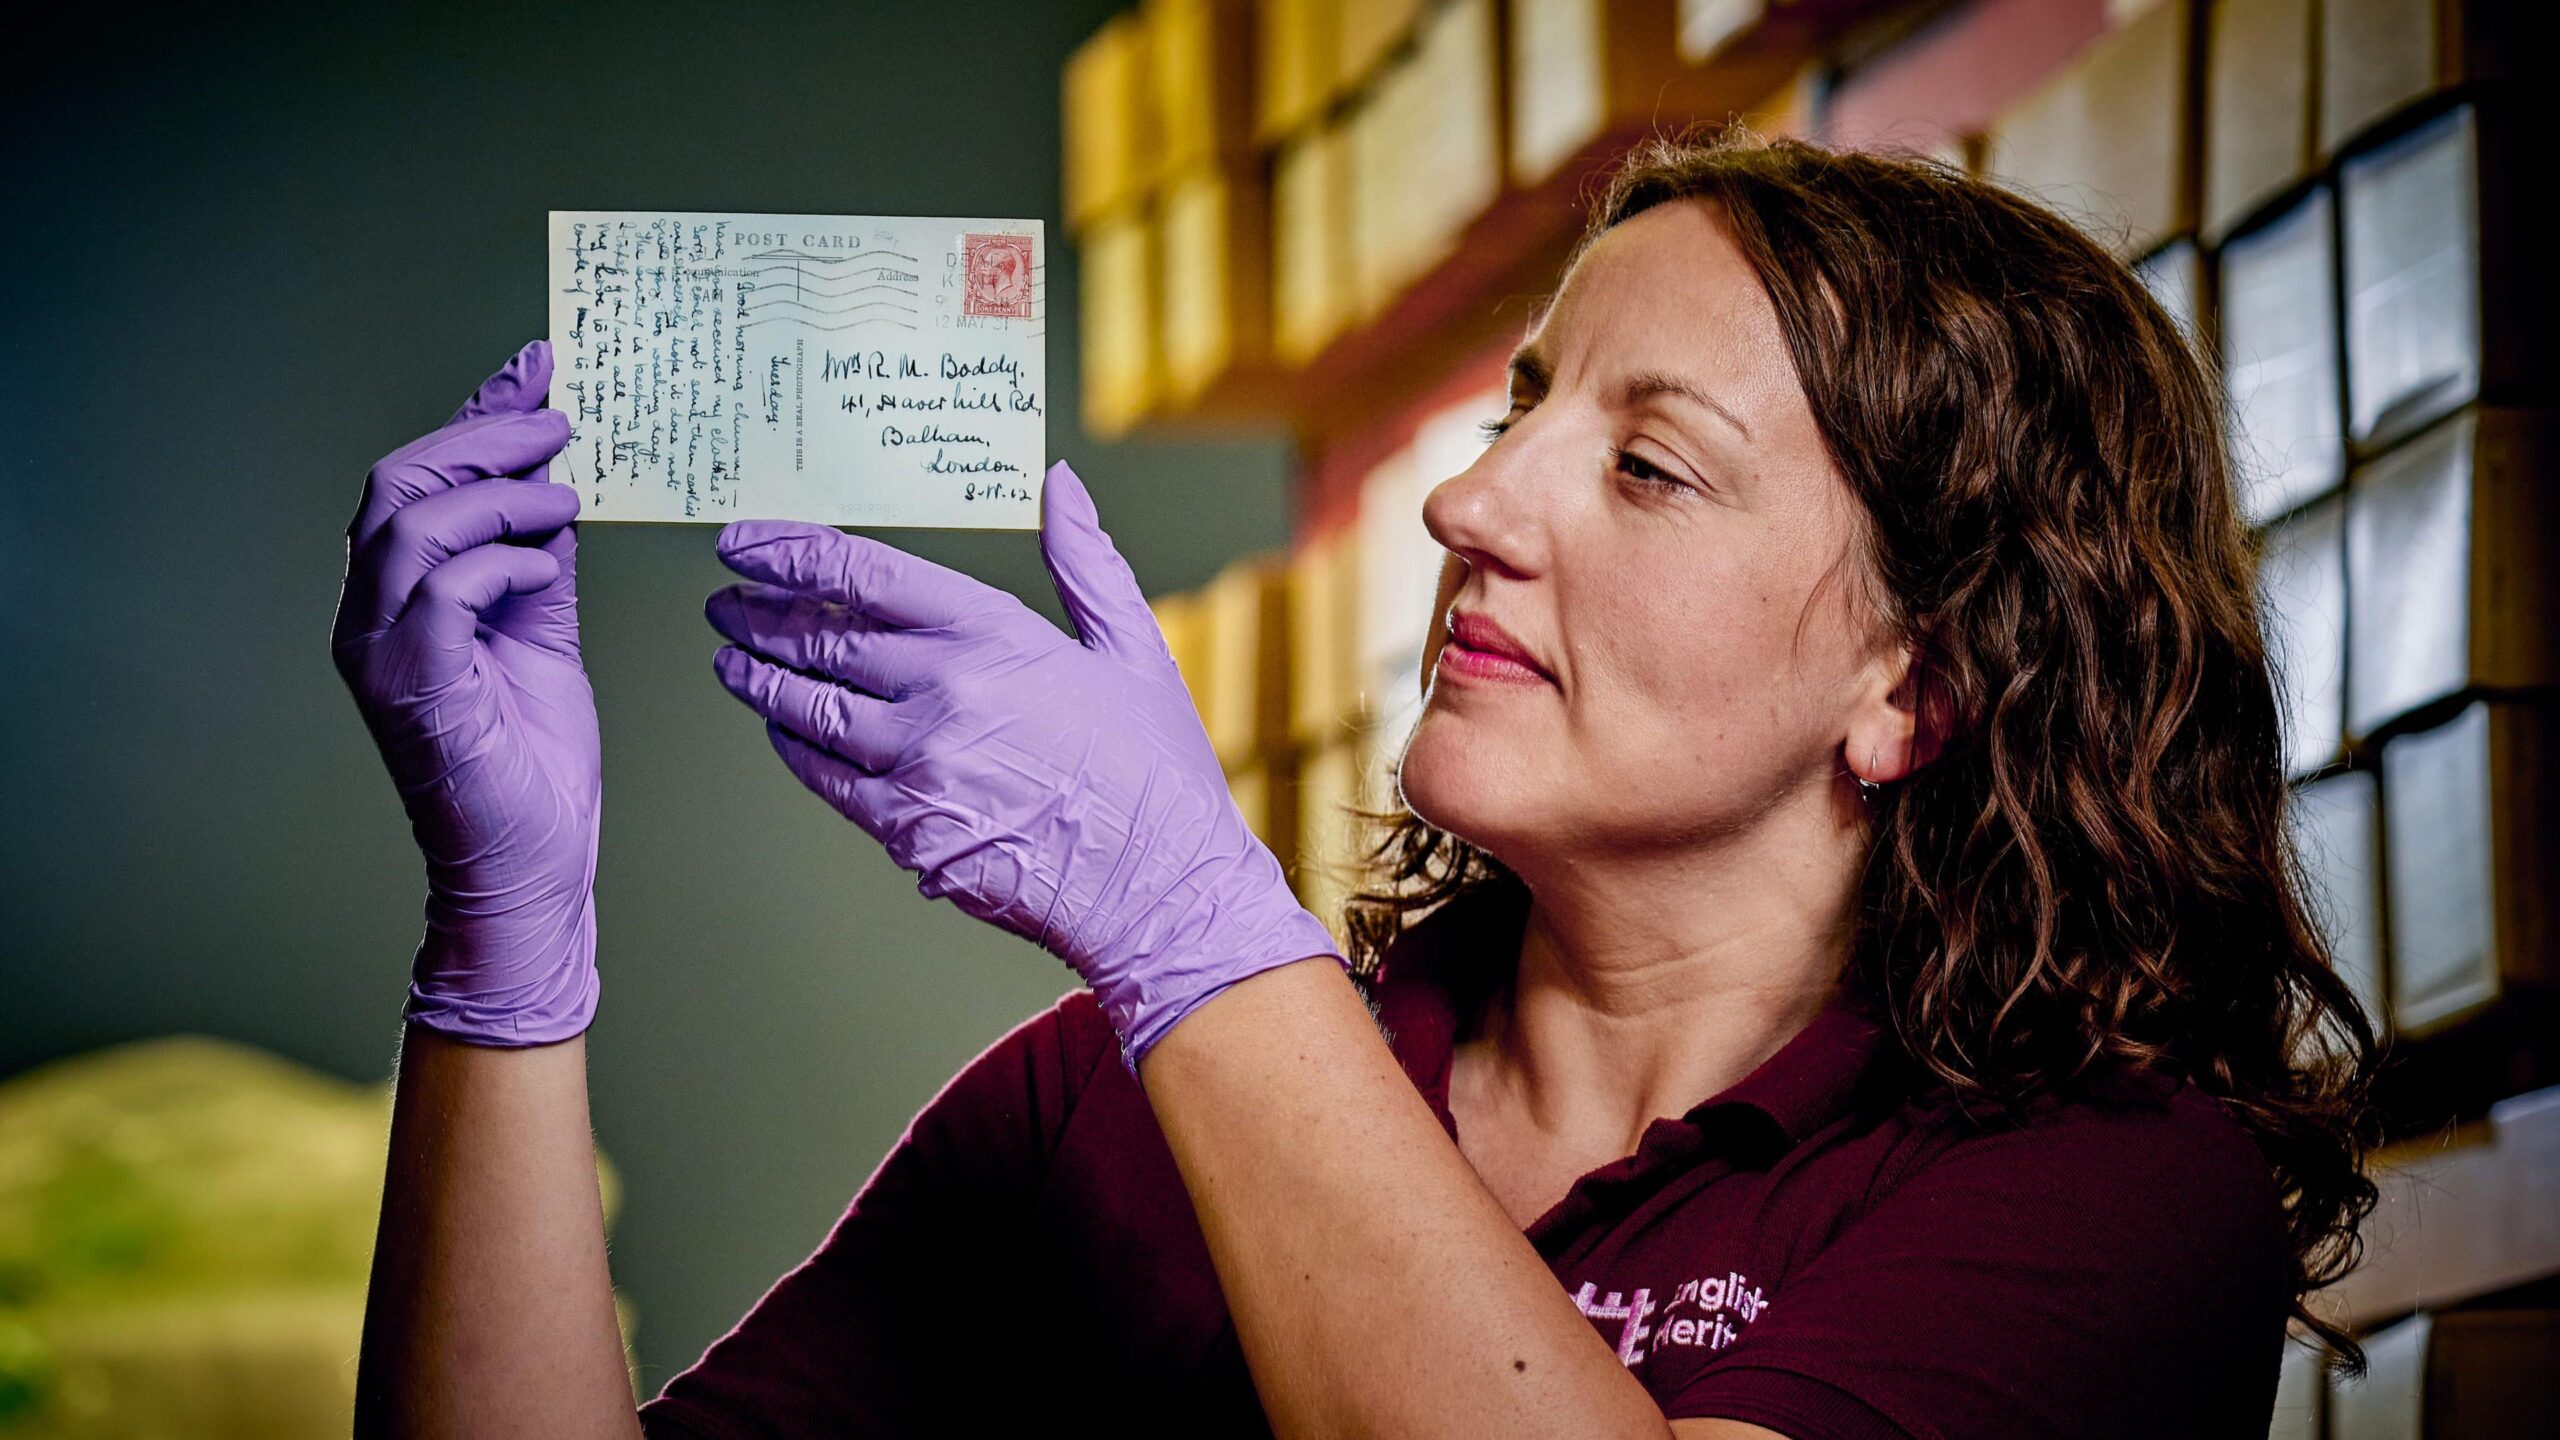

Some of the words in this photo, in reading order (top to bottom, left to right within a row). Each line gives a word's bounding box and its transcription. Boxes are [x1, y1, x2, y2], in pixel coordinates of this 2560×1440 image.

[566, 224, 590, 274] couple
[635, 231, 653, 260] The
[652, 219, 672, 260] give
[673, 221, 689, 254] and
[689, 225, 707, 262] Sorry
[716, 221, 732, 259] have
[734, 232, 788, 246] POST
[802, 233, 861, 248] CARD
[563, 279, 591, 295] of
[666, 258, 688, 328] sincerely
[877, 270, 919, 282] Address
[634, 266, 648, 328] weather
[691, 286, 703, 330] could
[737, 282, 756, 319] Good
[593, 319, 610, 332] to
[956, 315, 985, 328] MAY
[596, 342, 609, 369] the
[614, 327, 622, 357] are
[633, 337, 648, 353] is
[664, 337, 684, 376] hope
[690, 338, 708, 369] not
[713, 308, 729, 384] received
[733, 326, 751, 391] morning
[575, 357, 594, 369] to
[647, 348, 667, 415] washing
[796, 339, 804, 400] PHOTOGRAPH
[567, 380, 586, 421] you
[583, 380, 609, 423] boys
[614, 365, 625, 402] all
[628, 363, 649, 431] keeping
[670, 383, 685, 399] it
[688, 379, 703, 422] send
[877, 381, 1001, 412] Haverhill
[701, 395, 721, 418] my
[670, 407, 684, 444] does
[796, 438, 803, 447] IS
[596, 436, 607, 483] and
[688, 423, 702, 467] them
[667, 452, 681, 490] not
[595, 493, 605, 506] a
[686, 473, 701, 517] earlier
